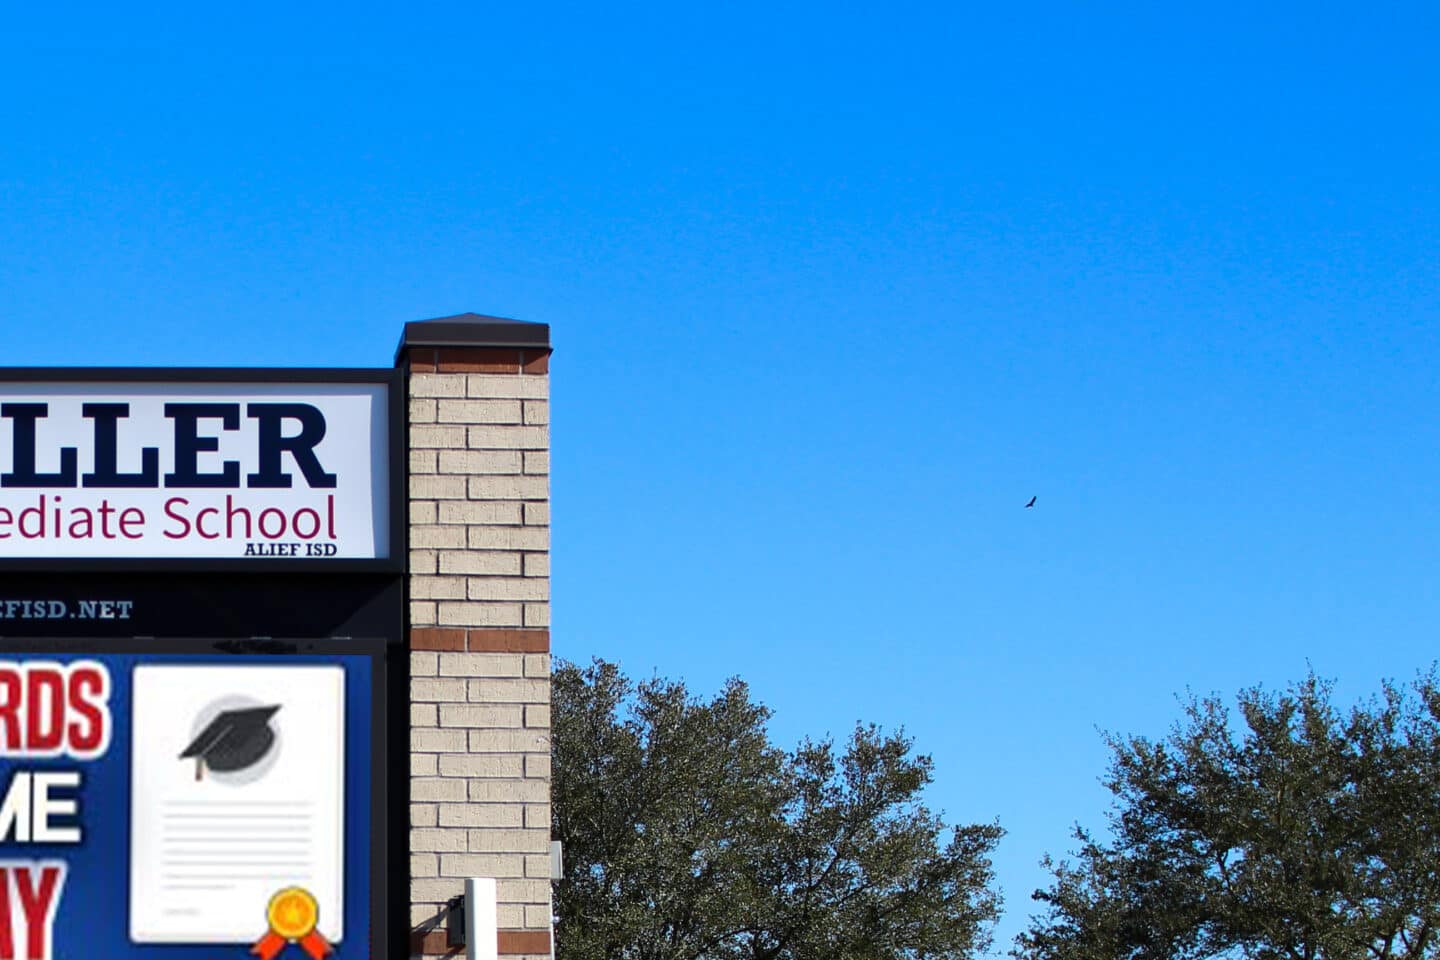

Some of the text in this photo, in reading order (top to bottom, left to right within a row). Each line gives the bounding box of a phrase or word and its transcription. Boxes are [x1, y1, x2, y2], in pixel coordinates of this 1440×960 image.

[163, 494, 337, 539] School
[244, 543, 337, 557] ALIEF ISD
